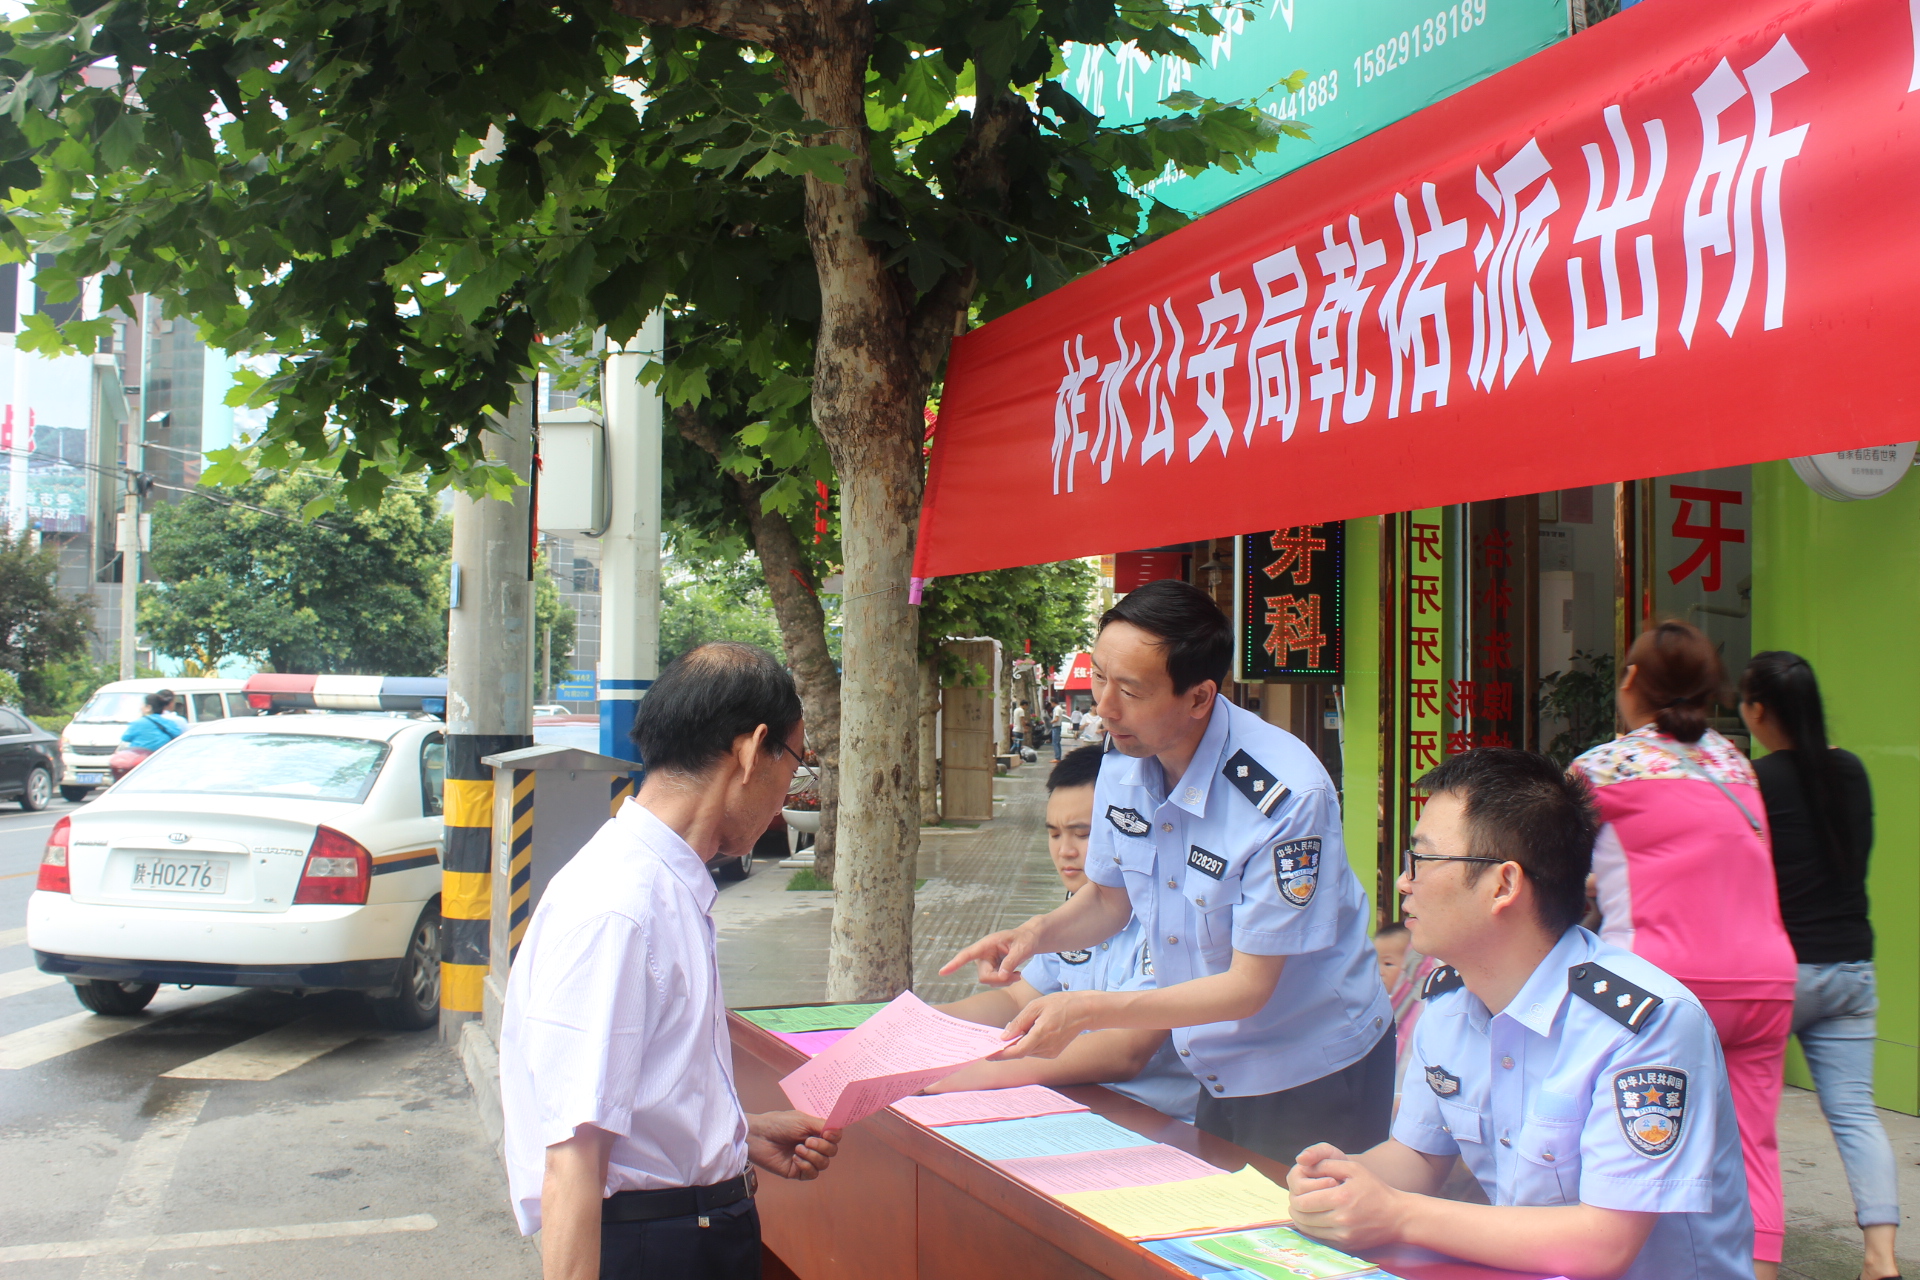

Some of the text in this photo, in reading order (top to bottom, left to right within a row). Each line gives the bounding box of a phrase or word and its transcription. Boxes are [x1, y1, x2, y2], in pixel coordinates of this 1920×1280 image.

[1353, 0, 1487, 88] 15829138189
[1051, 33, 1810, 495] 柞水公安局乾佑派出所
[1667, 484, 1745, 592] 牙
[1262, 520, 1327, 668] 牙科
[1191, 850, 1223, 875] 028297
[1617, 1072, 1684, 1091] 中华人民共和国
